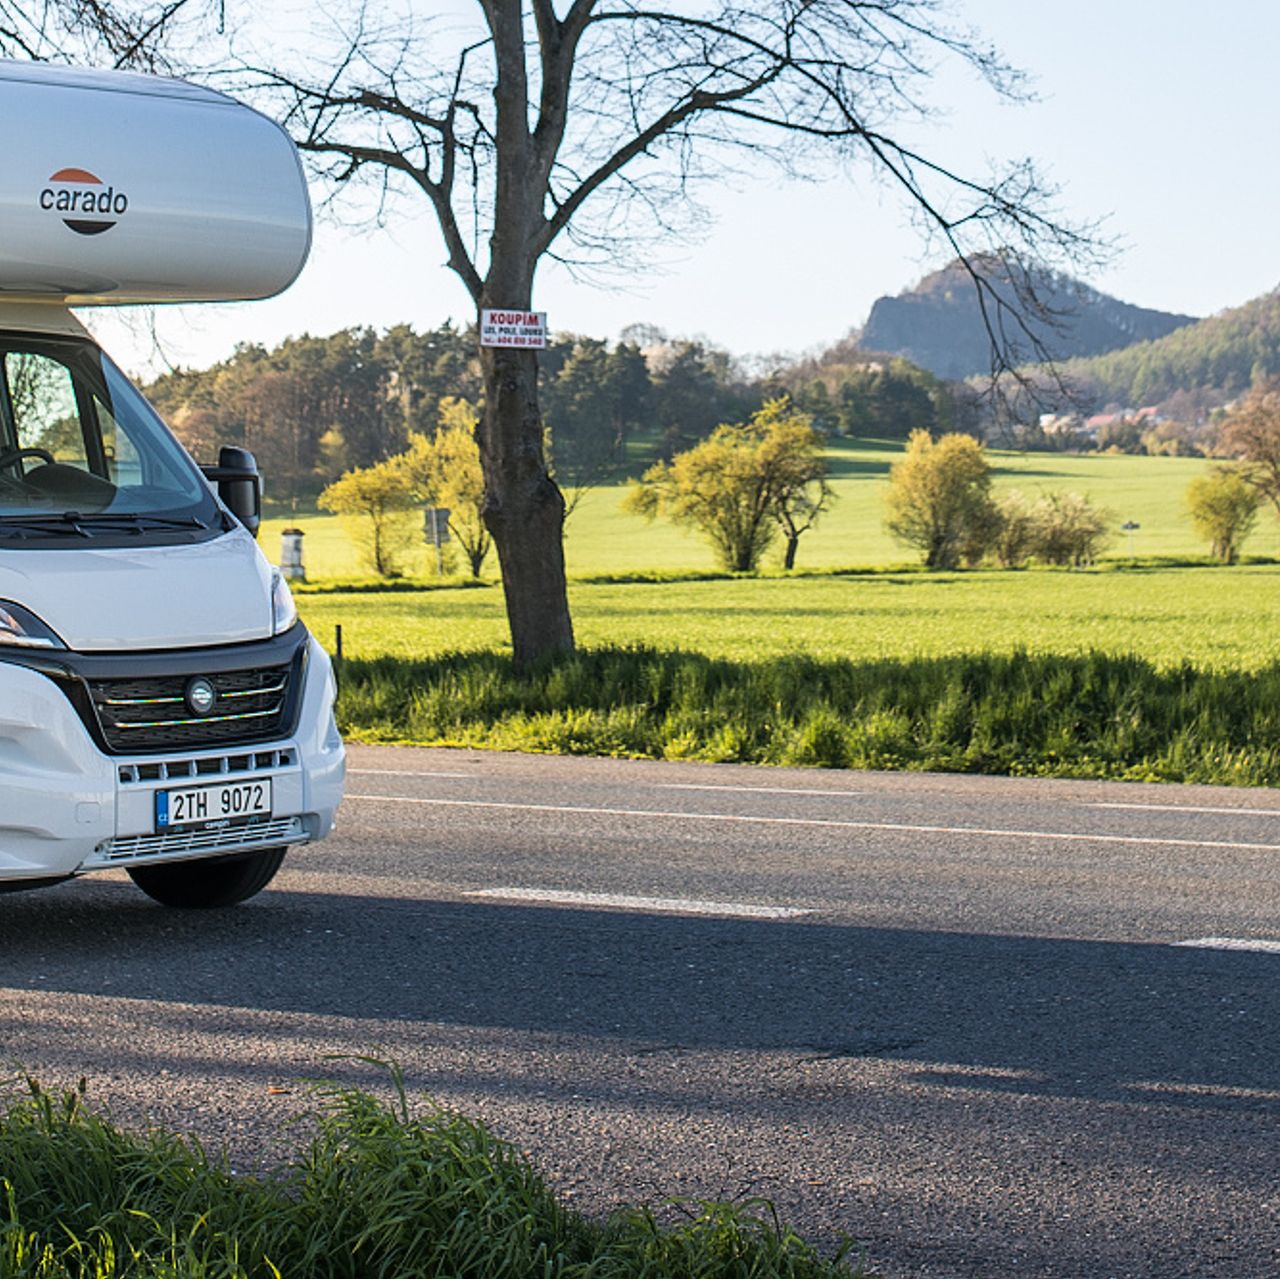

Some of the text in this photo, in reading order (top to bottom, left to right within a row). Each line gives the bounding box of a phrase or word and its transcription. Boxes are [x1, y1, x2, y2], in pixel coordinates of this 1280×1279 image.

[39, 186, 128, 214] carado
[173, 785, 263, 820] 2TH 9072
